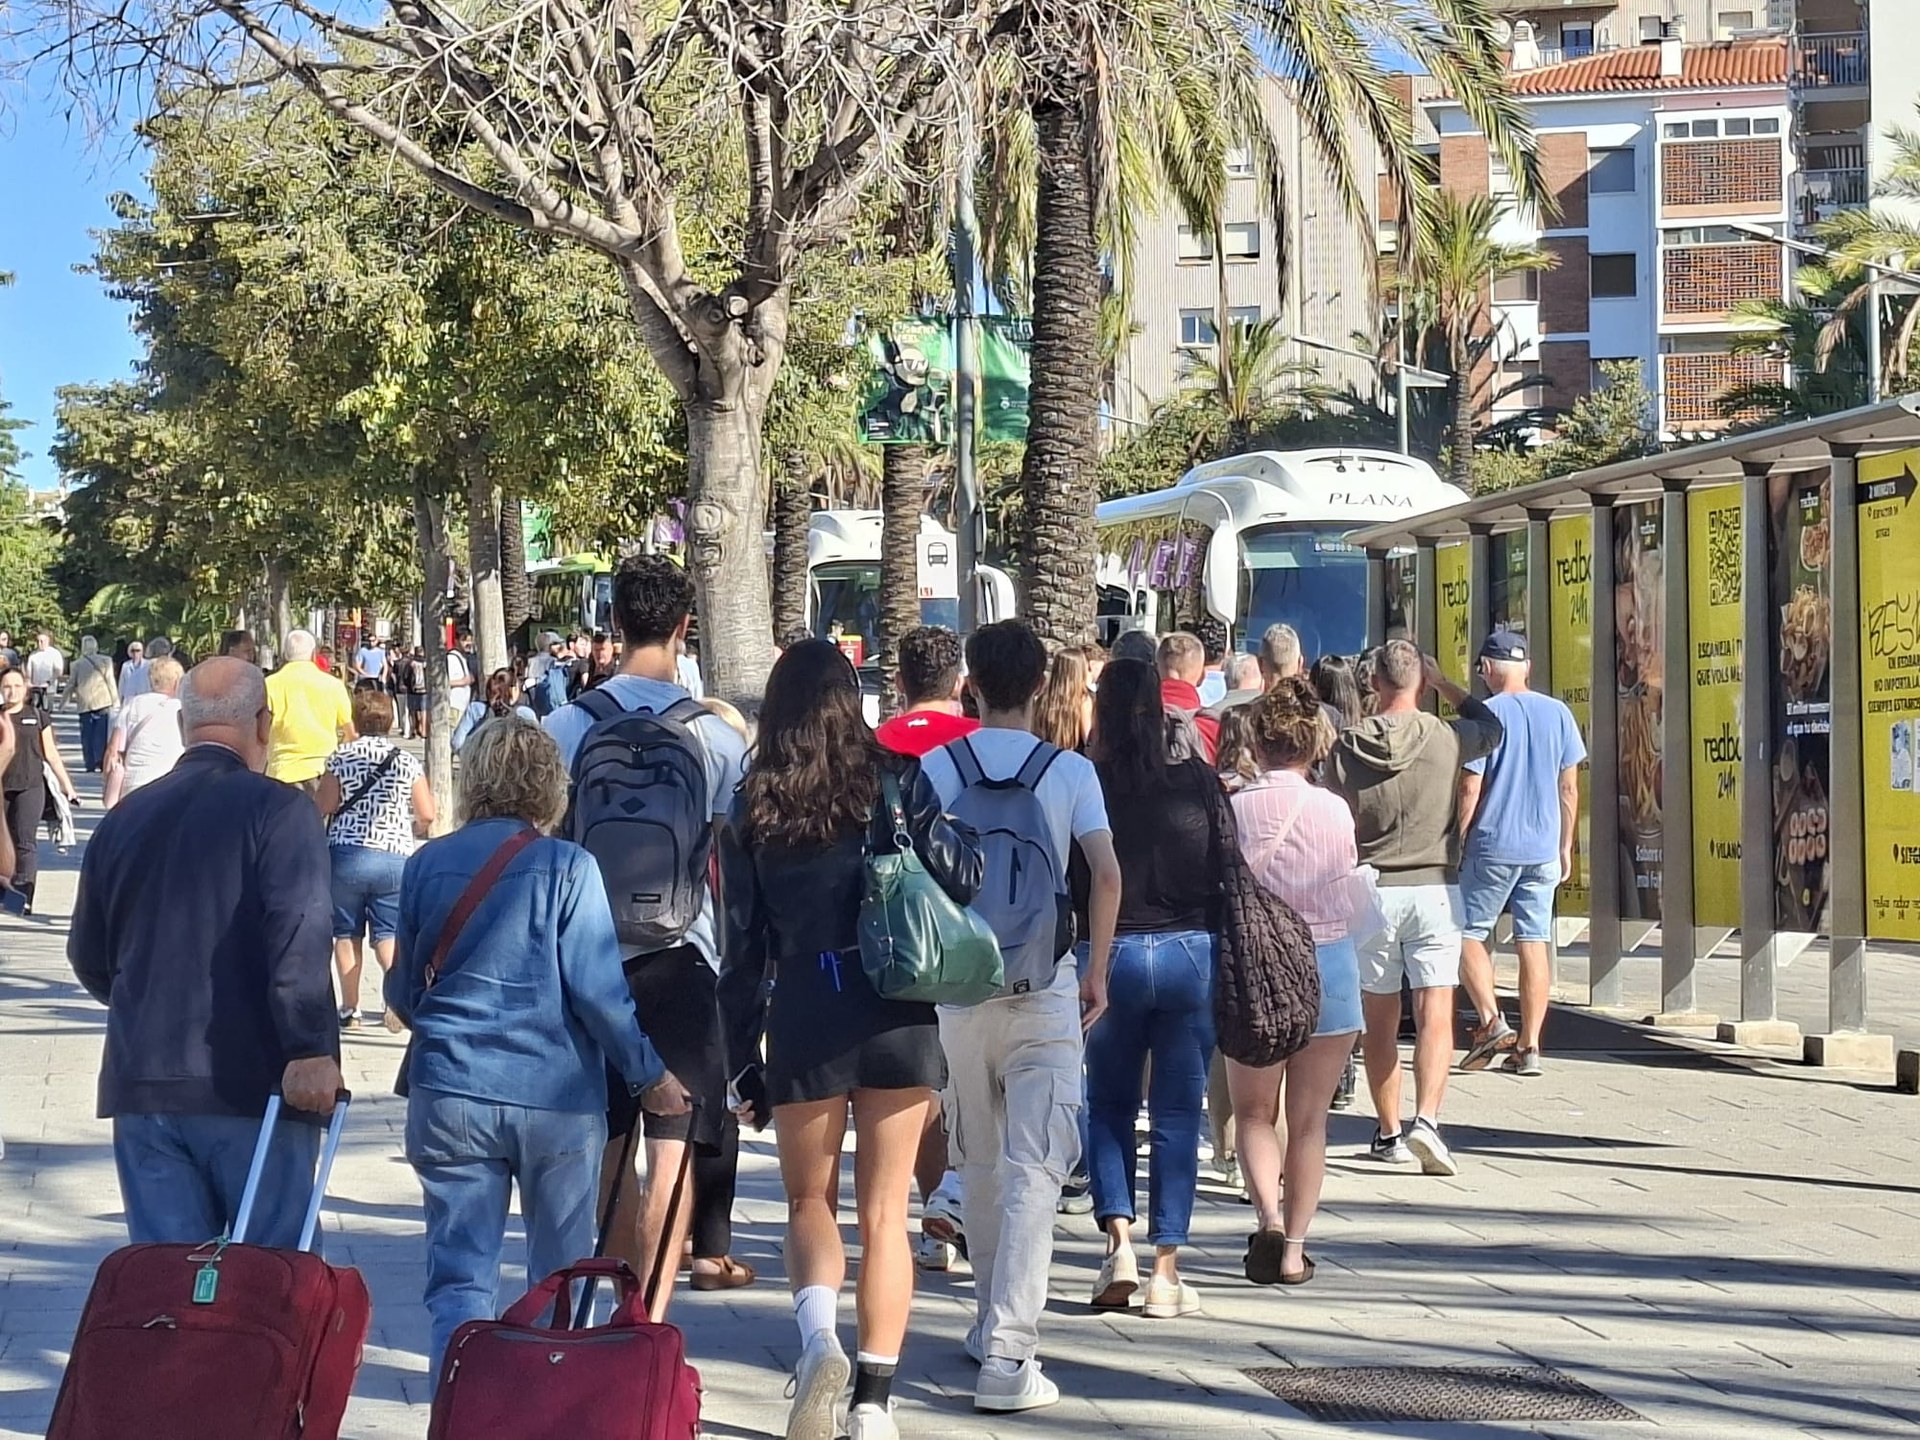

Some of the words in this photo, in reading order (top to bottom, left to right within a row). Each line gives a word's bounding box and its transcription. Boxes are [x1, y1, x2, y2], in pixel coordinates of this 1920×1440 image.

[1329, 493, 1413, 507] PLANA
[1442, 565, 1469, 608] redb
[1716, 841, 1742, 860] VILANO
